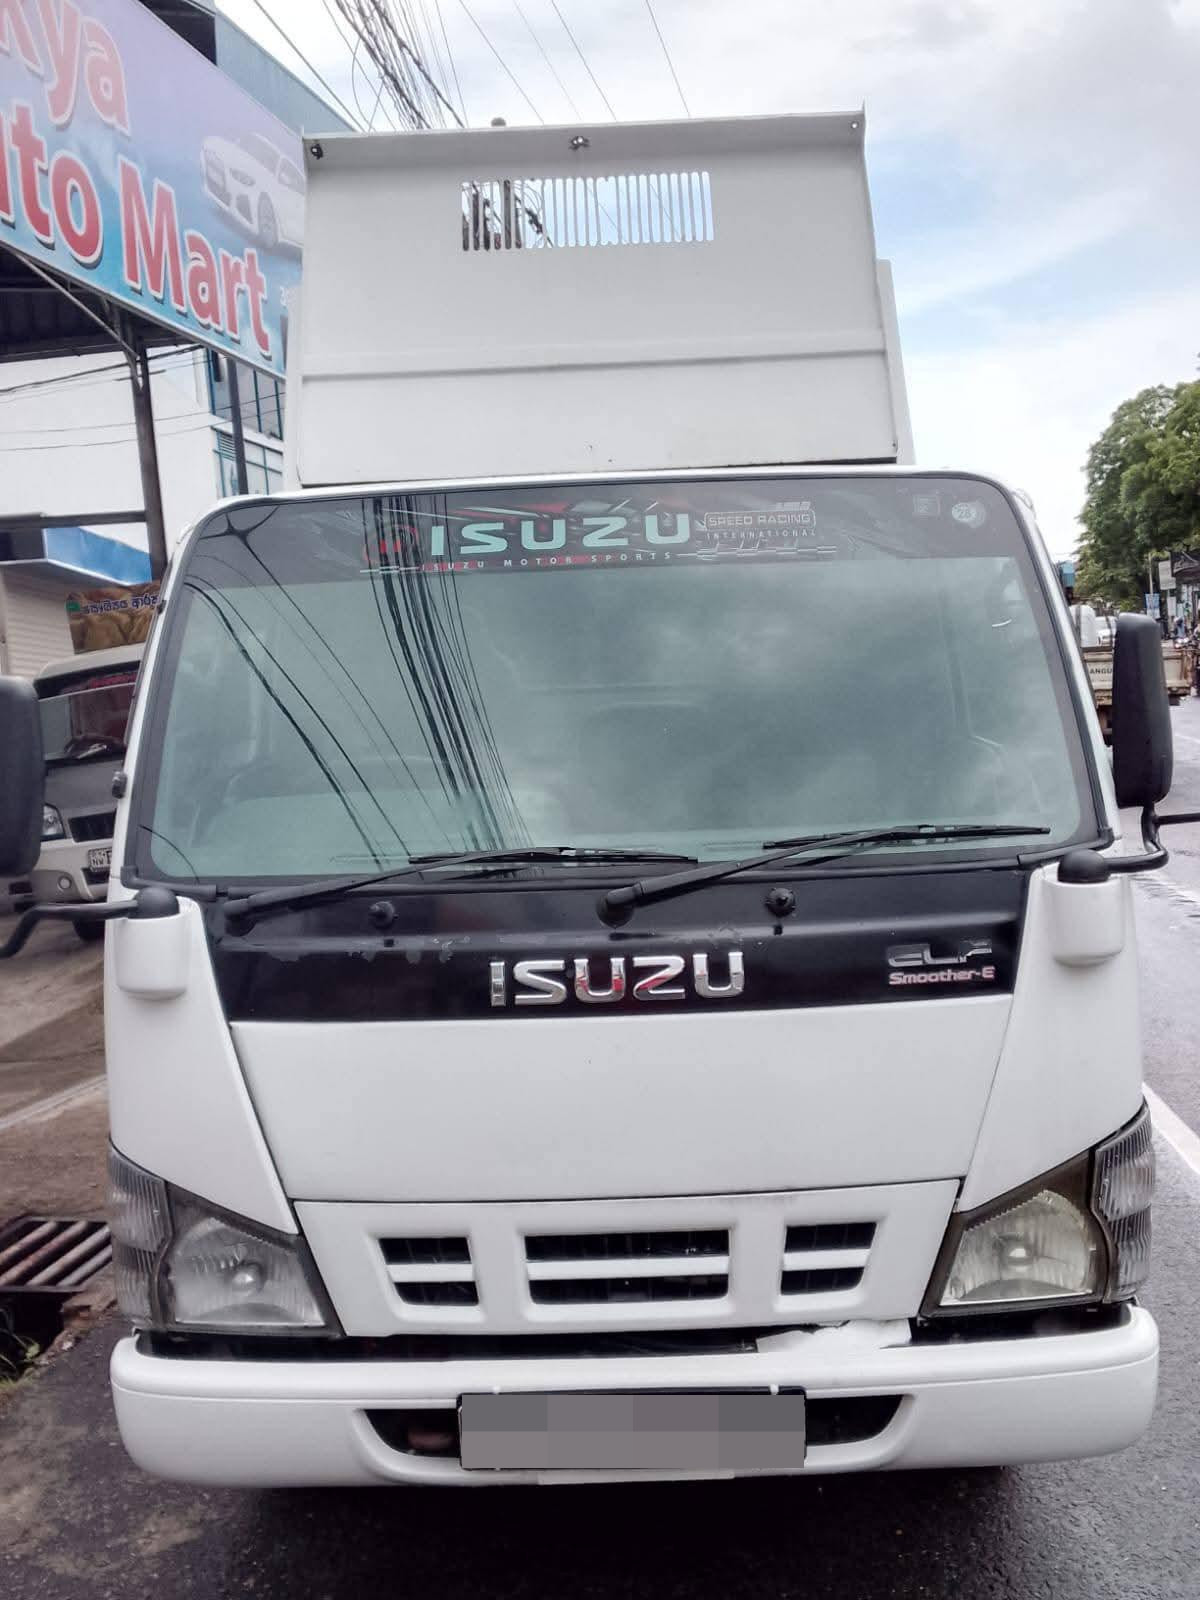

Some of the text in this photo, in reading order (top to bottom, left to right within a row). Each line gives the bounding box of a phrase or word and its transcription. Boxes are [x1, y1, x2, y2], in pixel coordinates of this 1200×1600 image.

[0, 0, 131, 138] ya
[117, 153, 273, 362] Mart
[430, 512, 690, 556] ISUZU
[708, 512, 811, 527] SPEED RACING
[421, 551, 672, 571] ISUZU MOTOR SPORTS
[489, 951, 745, 1007] ISUZU
[888, 965, 996, 985] Smoother-E
